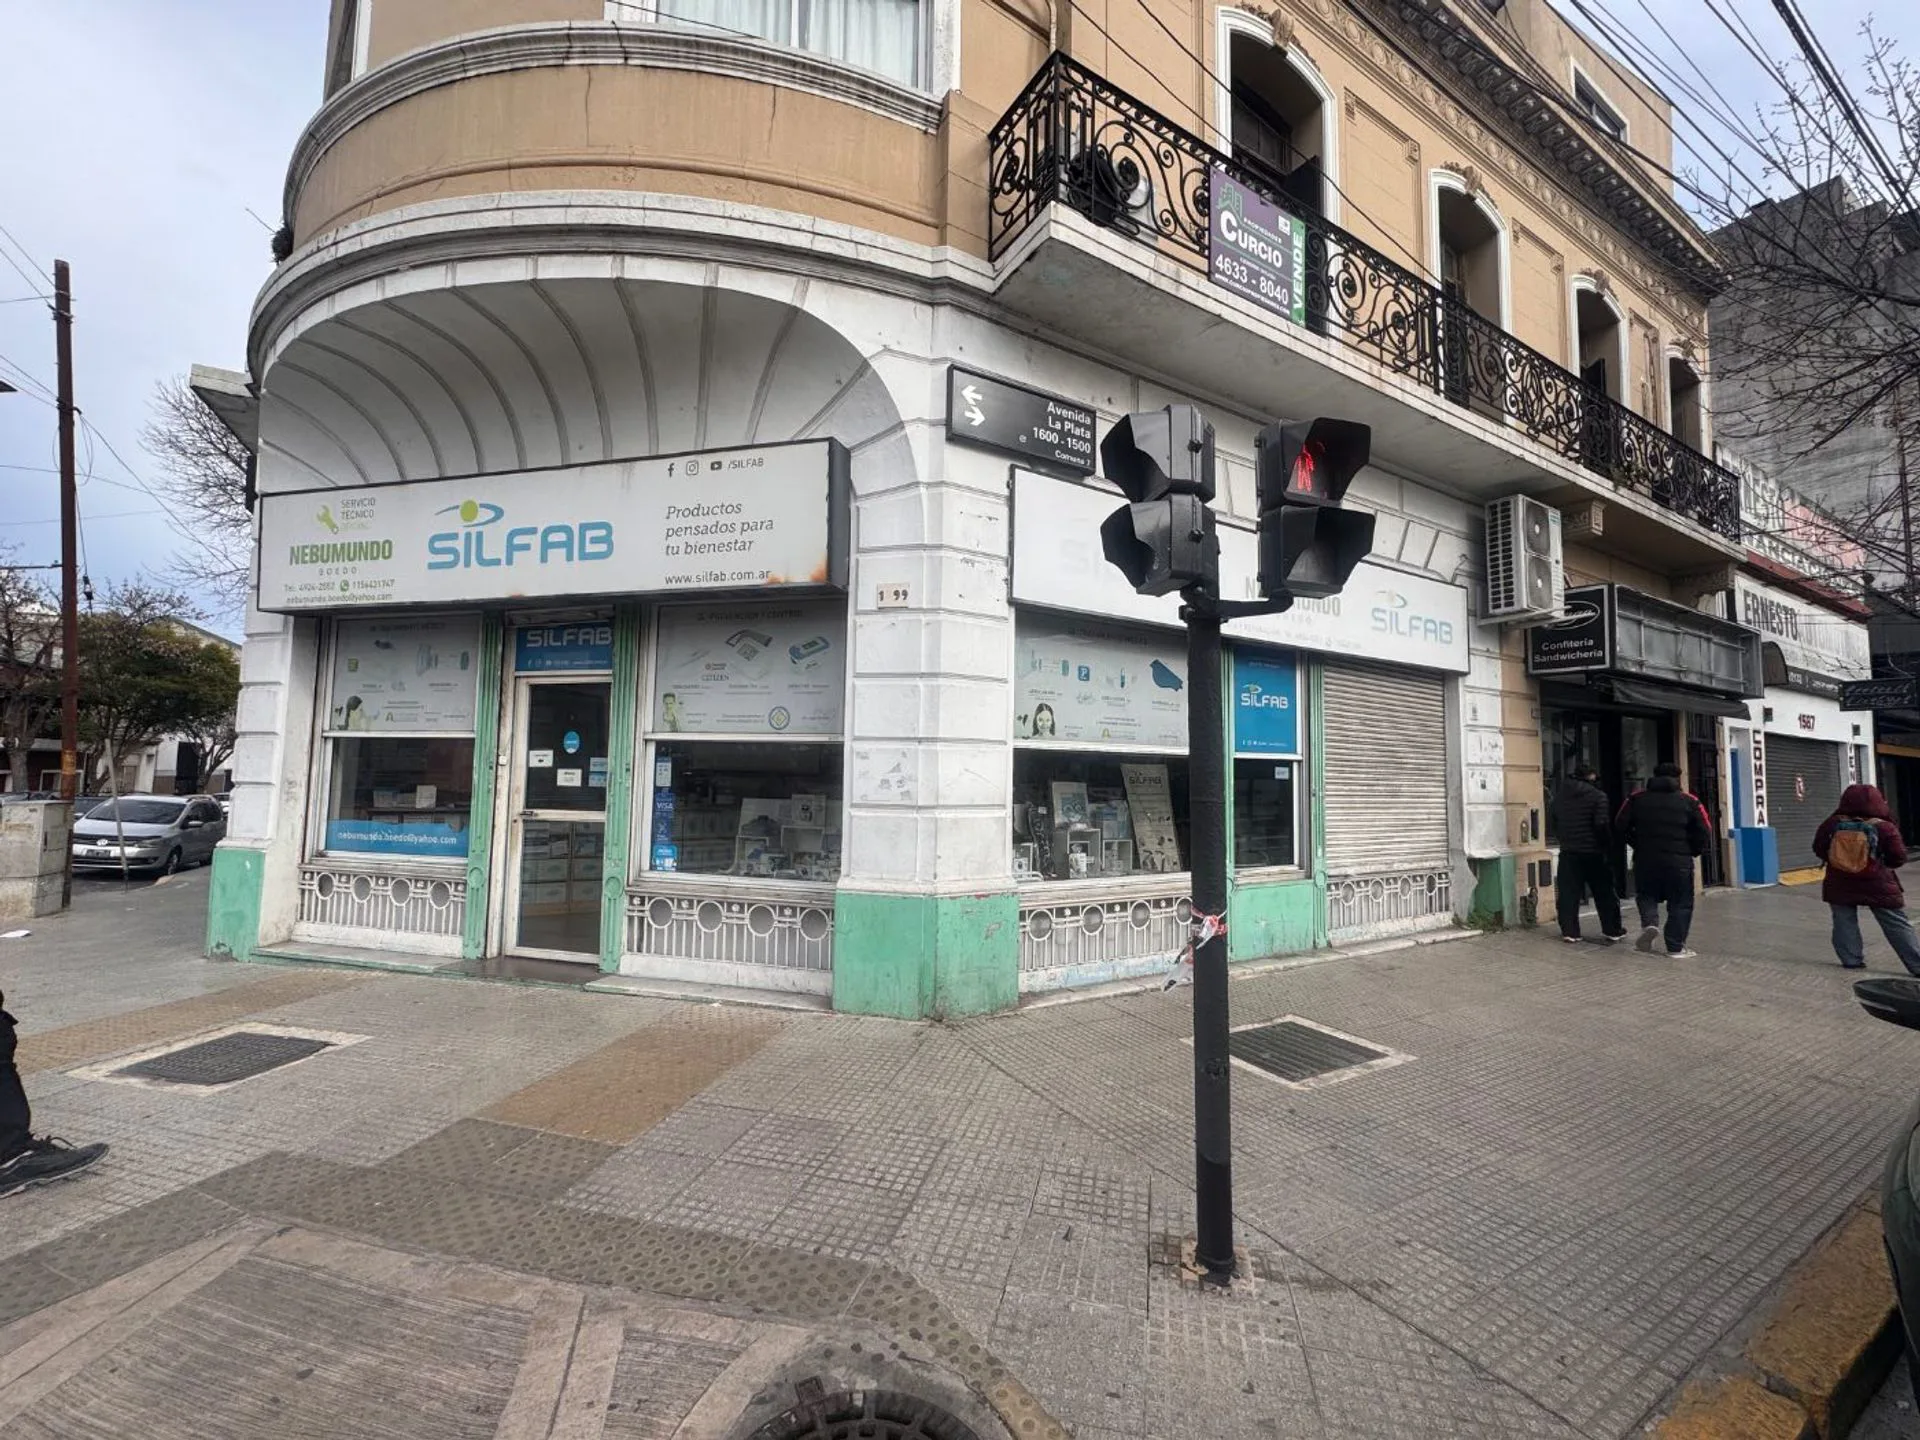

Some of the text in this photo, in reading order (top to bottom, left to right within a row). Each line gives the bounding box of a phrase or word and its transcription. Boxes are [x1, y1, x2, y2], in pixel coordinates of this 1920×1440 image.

[1220, 210, 1283, 268] CURCIO
[1215, 253, 1248, 284] 4633
[1259, 276, 1289, 306] 8040
[1292, 231, 1304, 310] VENDE
[1047, 401, 1091, 425] Avenida
[1048, 415, 1091, 439] La Plata
[1033, 426, 1059, 444] 1600
[1066, 437, 1091, 454] 1500
[1055, 450, 1085, 465] Comuna
[340, 497, 376, 509] SERVICIO
[665, 501, 742, 519] Productos
[665, 517, 774, 540] pensados para
[289, 539, 393, 566] NEBUMUNDO
[427, 521, 614, 570] SILFAB
[665, 537, 754, 556] tu bienestar
[665, 568, 771, 584] www.silfab.com.ar
[1371, 607, 1453, 645] SILFAB
[1743, 589, 1798, 642] ERNESTO
[526, 626, 613, 648] SILFAB
[1240, 692, 1289, 709] SILFAB
[1752, 729, 1766, 825] COMPRA
[656, 801, 673, 809] VISA
